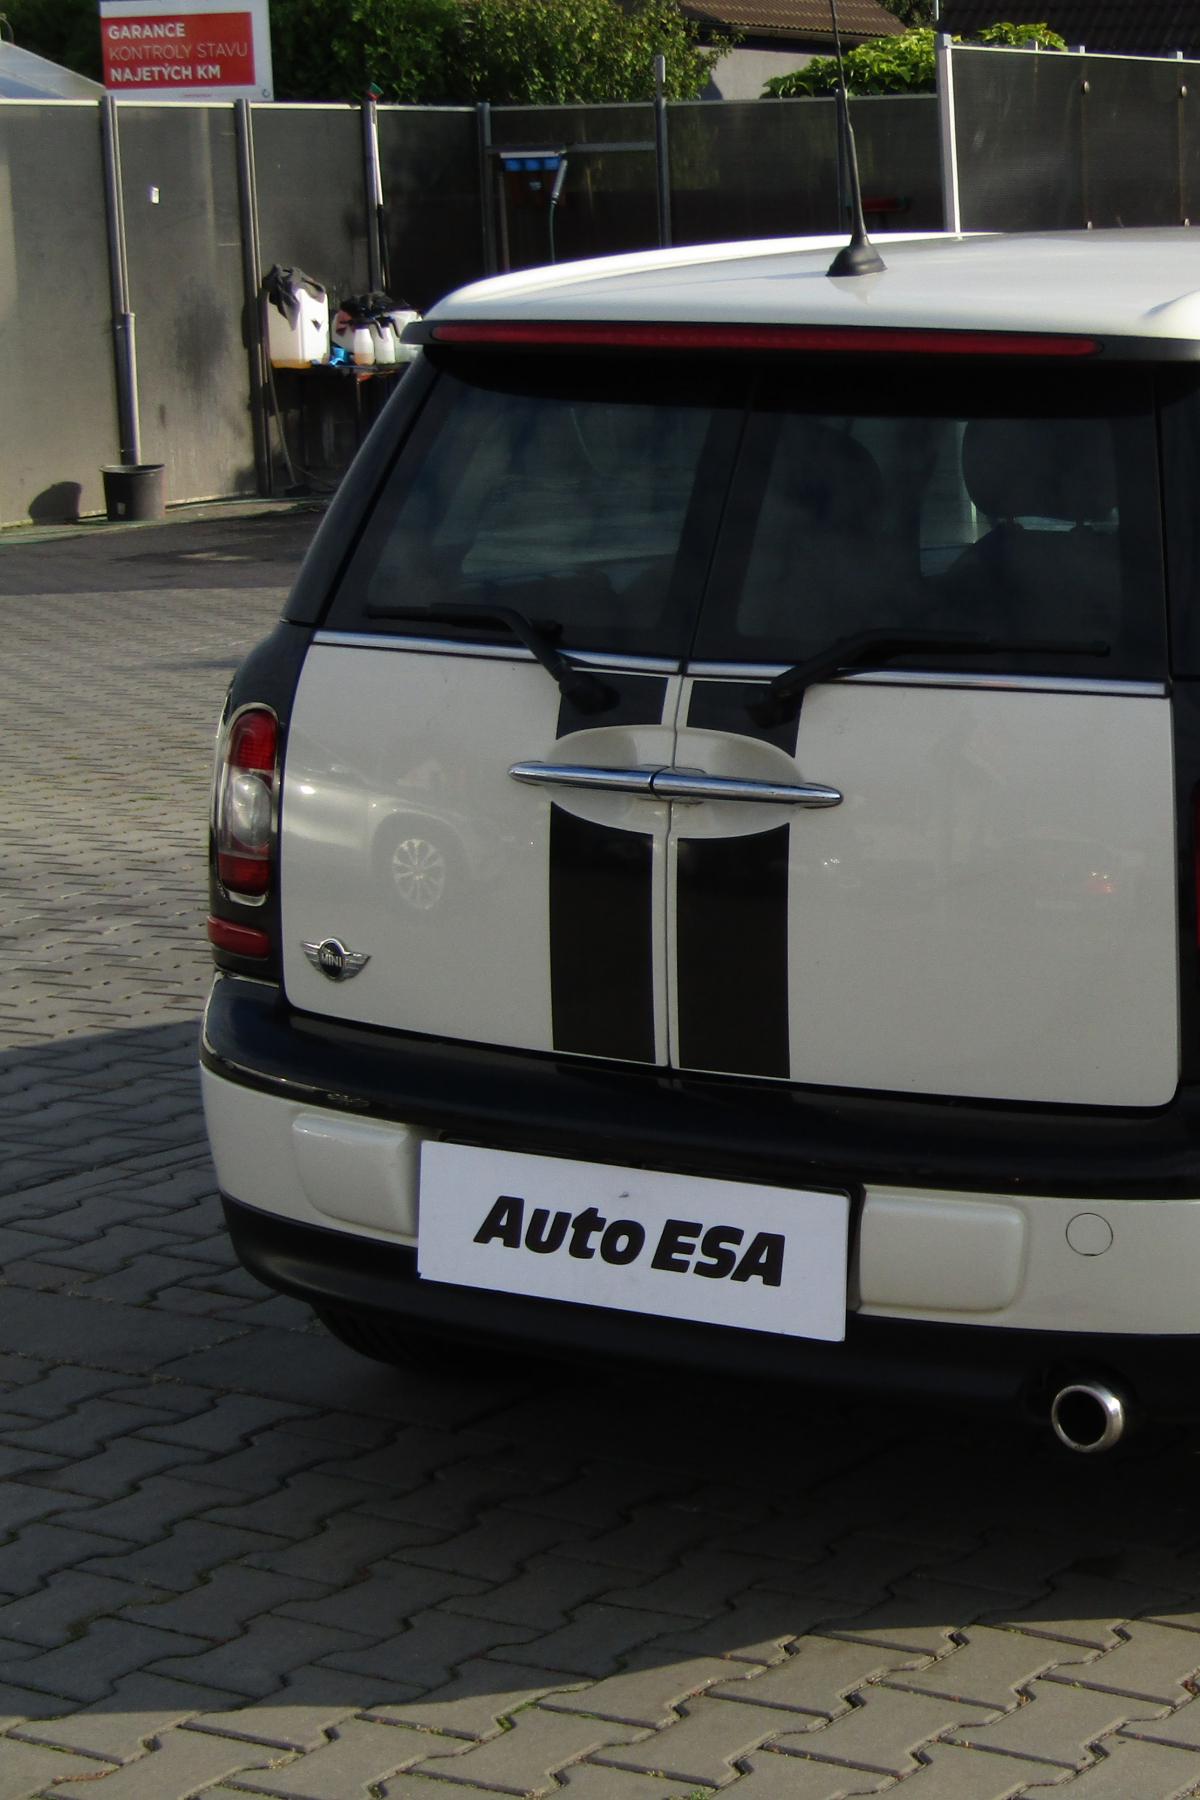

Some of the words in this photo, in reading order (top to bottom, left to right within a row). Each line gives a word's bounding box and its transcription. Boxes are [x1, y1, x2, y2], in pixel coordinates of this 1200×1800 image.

[108, 23, 185, 40] GARANCE
[109, 44, 192, 61] KONTROLY
[196, 42, 248, 58] STAVU
[110, 63, 192, 82] NAJETÝCH
[196, 64, 221, 80] KM
[473, 1196, 646, 1266] Auto
[650, 1218, 786, 1287] ESA
